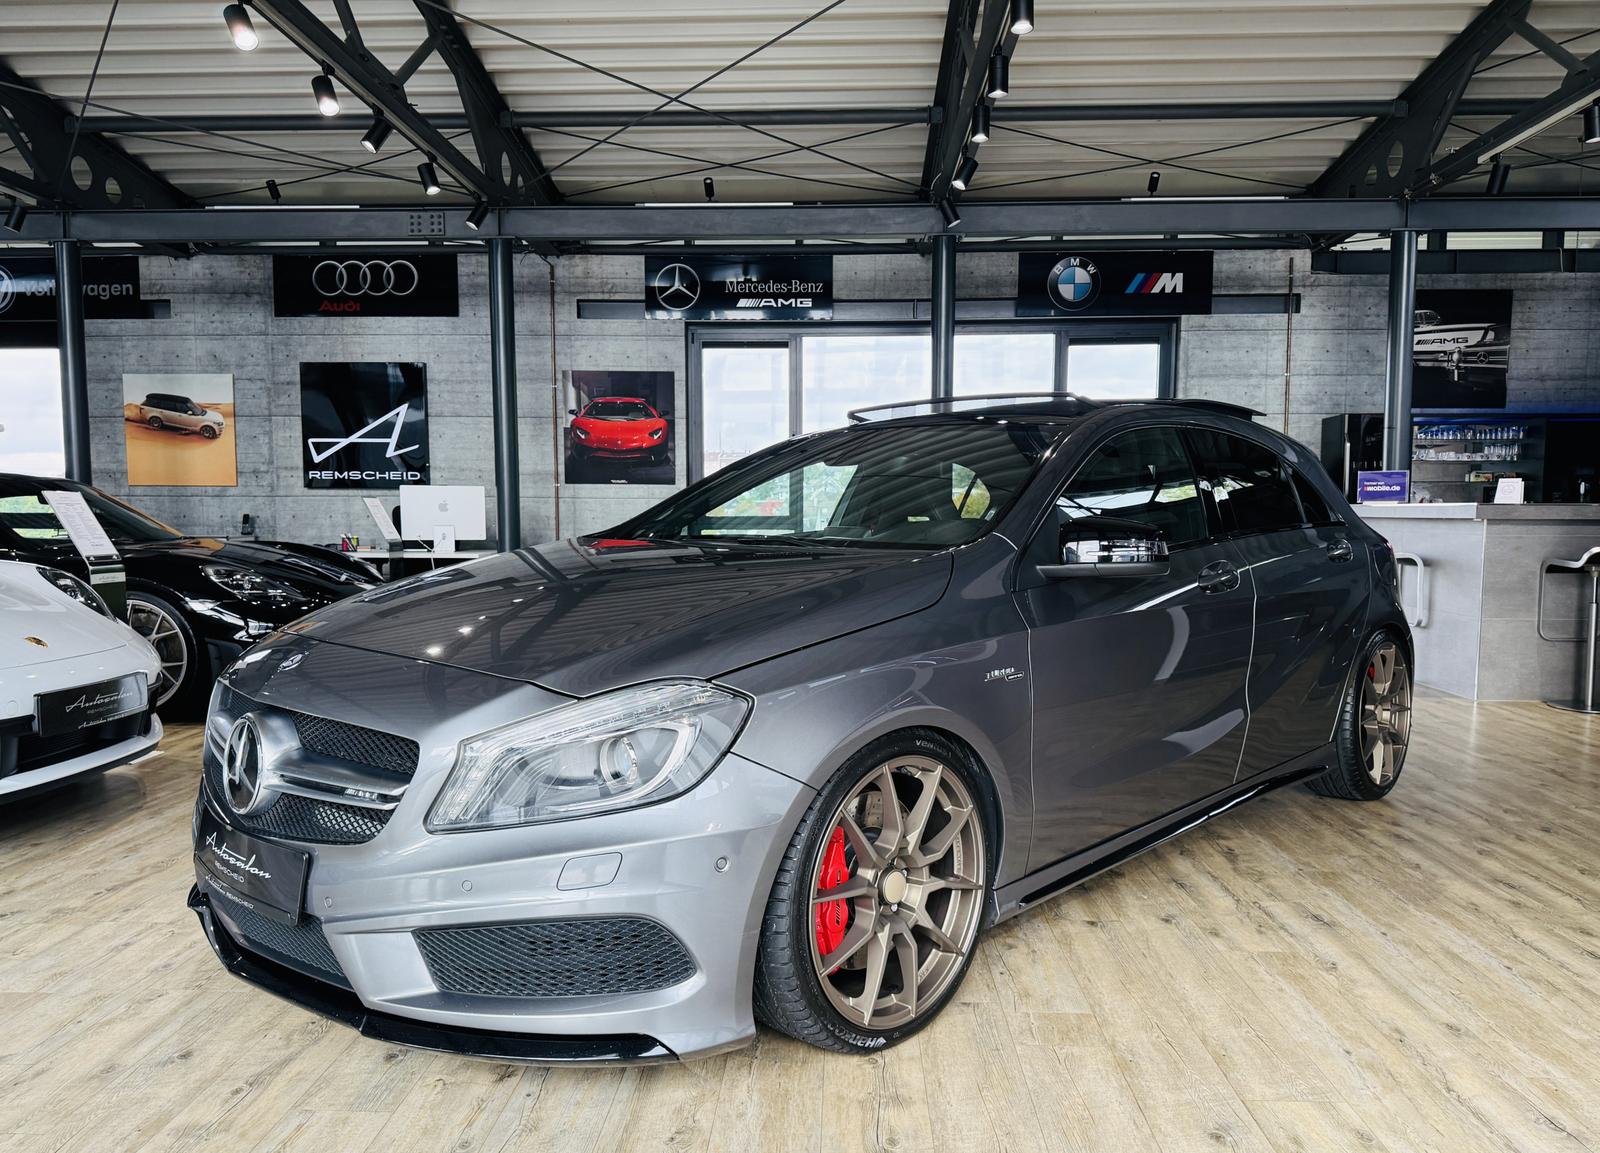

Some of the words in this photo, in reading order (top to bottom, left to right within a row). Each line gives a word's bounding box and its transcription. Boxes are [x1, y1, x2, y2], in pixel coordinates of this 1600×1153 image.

[1054, 257, 1096, 275] BMW
[25, 279, 133, 300] Volagen
[725, 280, 824, 293] Mercedes-Benz
[319, 299, 361, 311] Audi
[759, 298, 813, 308] AMG
[1430, 336, 1469, 345] AMG
[308, 470, 421, 480] REMSCHEID
[206, 831, 272, 879] Autosalon
